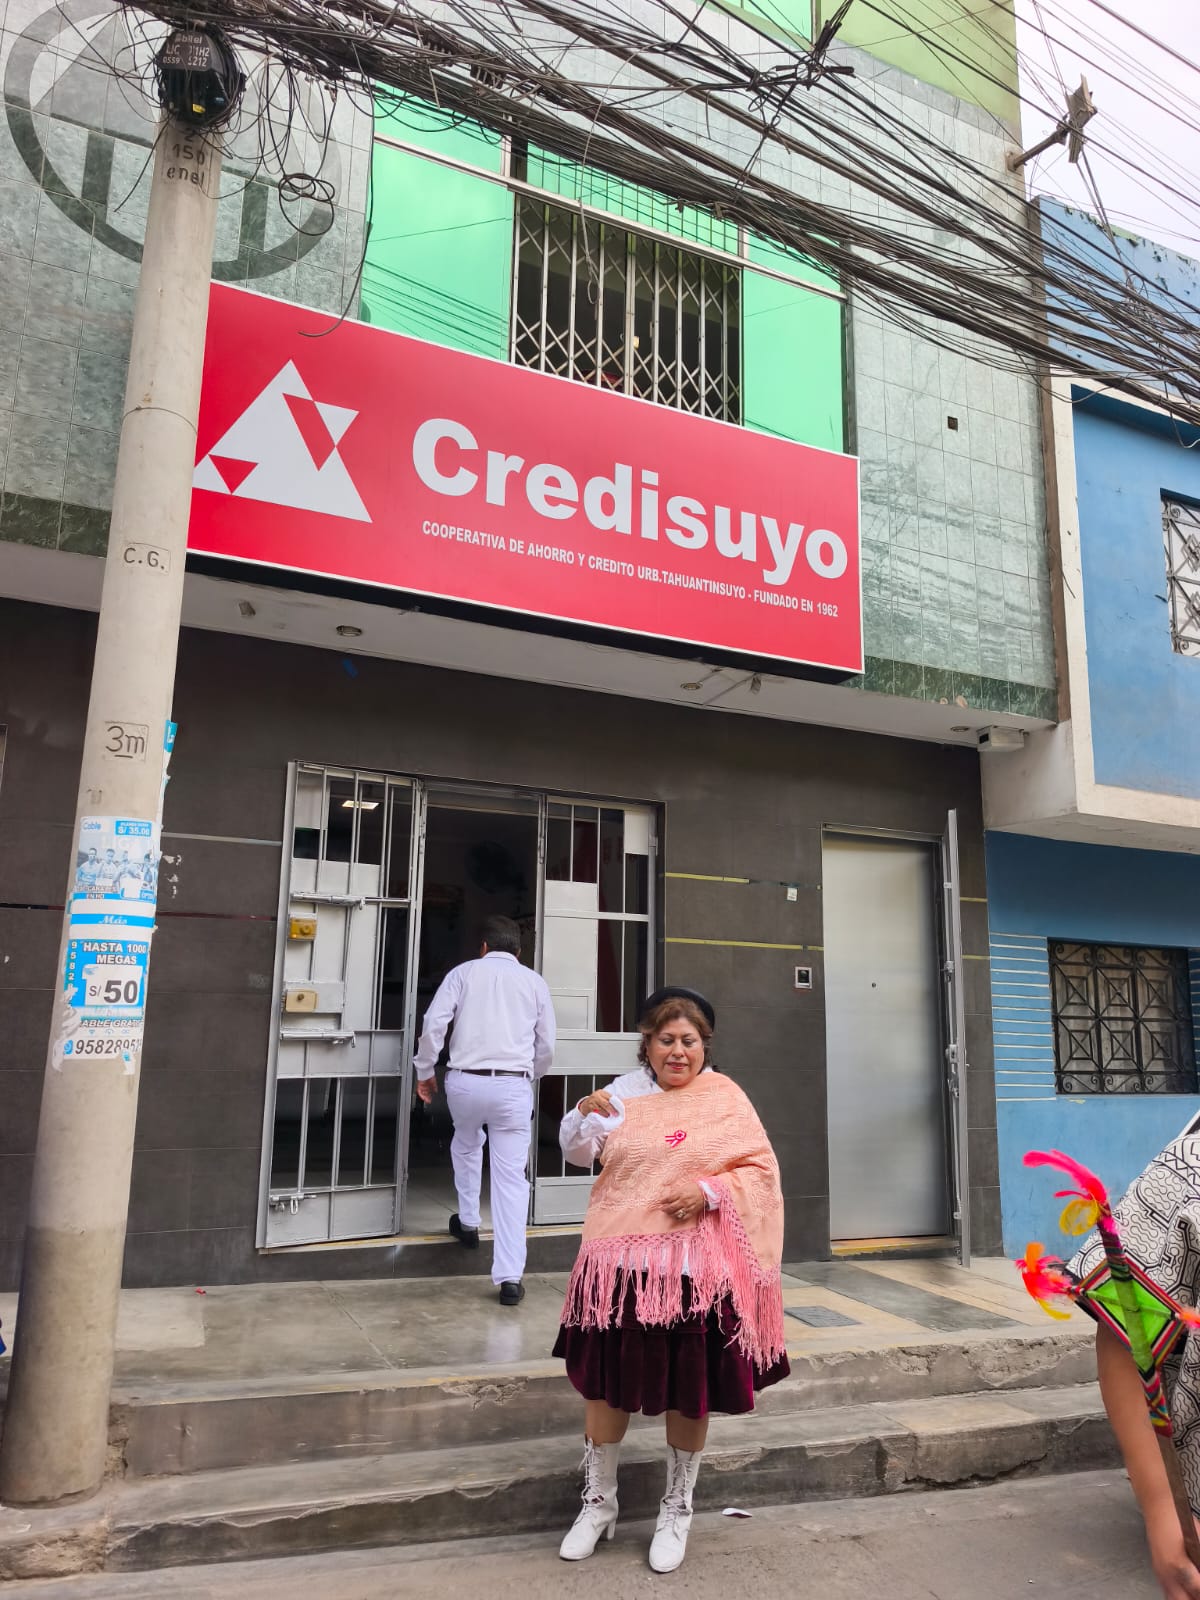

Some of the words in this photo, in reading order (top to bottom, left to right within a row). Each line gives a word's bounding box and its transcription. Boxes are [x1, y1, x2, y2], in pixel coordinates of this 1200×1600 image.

[172, 143, 206, 165] 150
[167, 167, 204, 188] enel
[412, 417, 848, 585] Credisuyo
[422, 520, 506, 550] COOPERATIVA
[509, 538, 525, 554] DE
[527, 542, 574, 565] AHORRO
[577, 552, 585, 566] Y
[588, 555, 634, 577] CREDITO
[753, 590, 799, 610] FUNDADO
[800, 599, 813, 613] EN
[816, 602, 839, 617] 1962
[105, 725, 145, 754] 3m
[82, 821, 102, 830] Cable
[83, 942, 123, 952] HASTA
[126, 943, 147, 954] 1000
[96, 954, 137, 965] MEGAS
[88, 984, 102, 997] S/
[103, 979, 139, 1004] 50
[80, 1019, 111, 1028] ABLE
